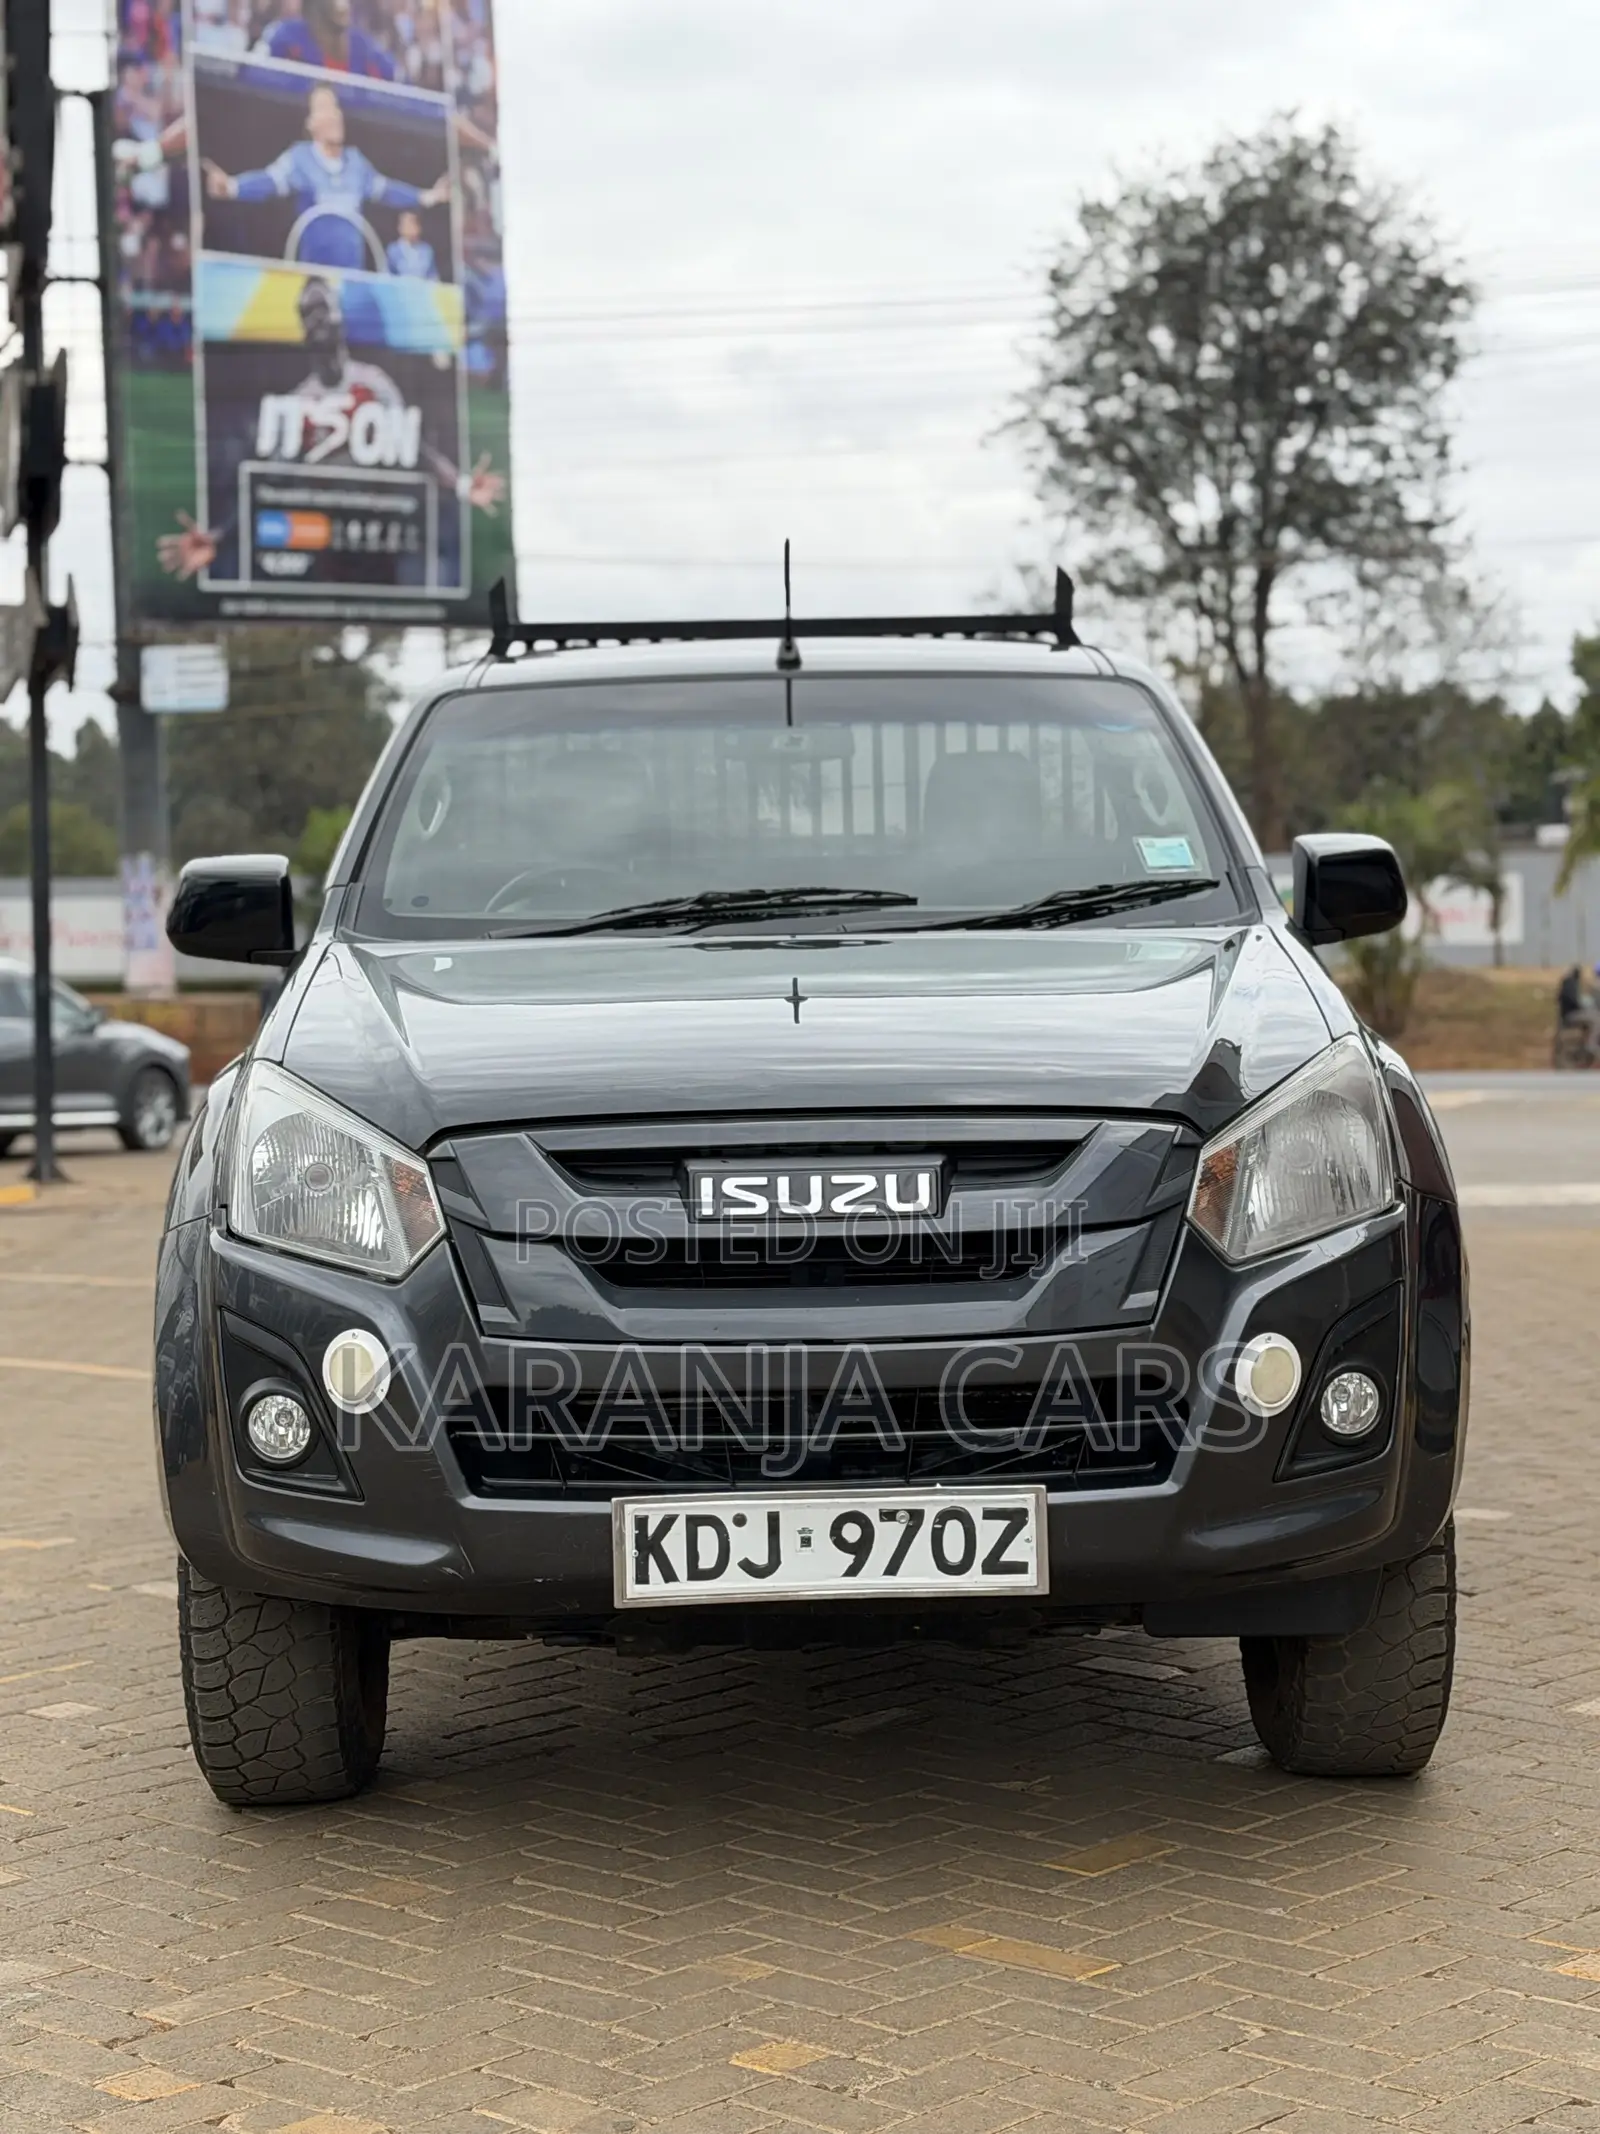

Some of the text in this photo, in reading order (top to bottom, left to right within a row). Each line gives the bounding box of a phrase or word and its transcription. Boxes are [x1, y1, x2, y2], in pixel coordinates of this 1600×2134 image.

[700, 1173, 931, 1216] ISUZU
[634, 1506, 1039, 1585] KDJ 970Z
